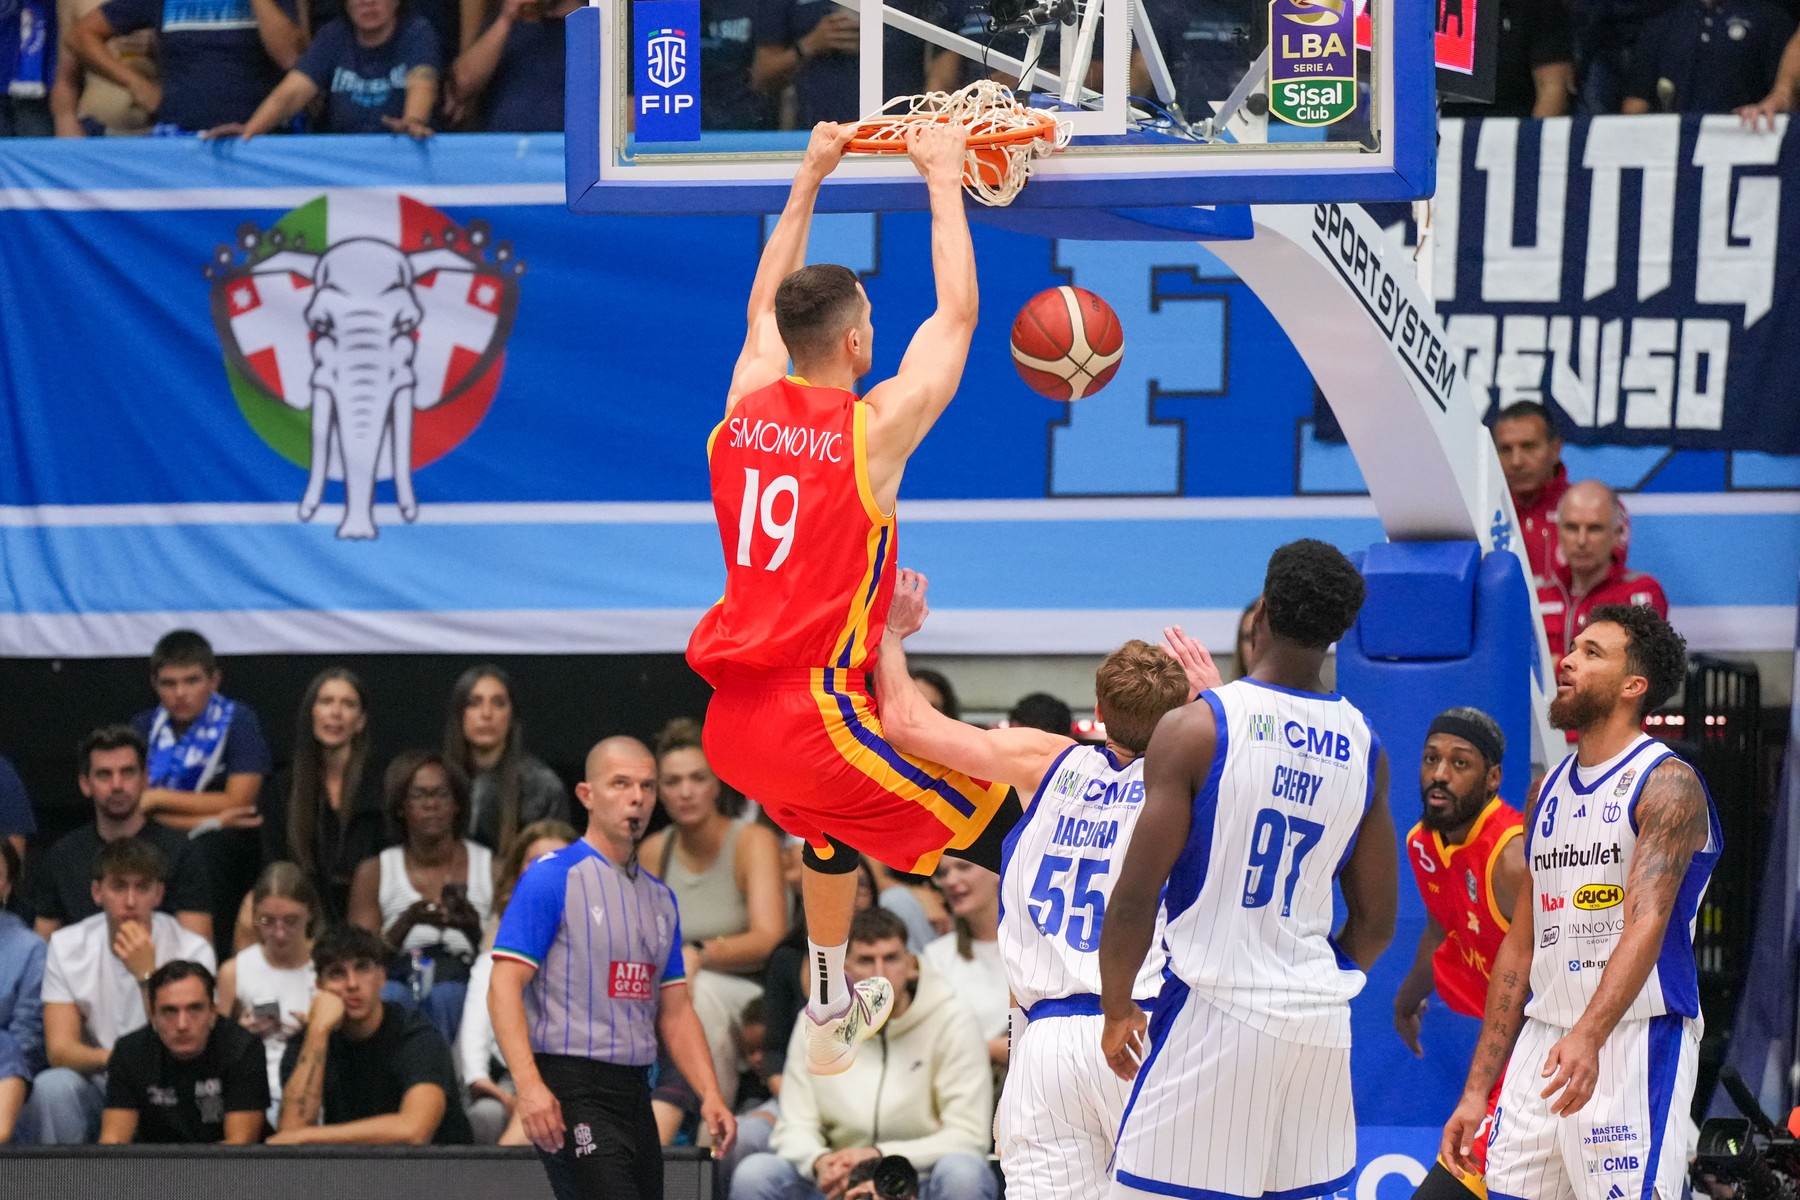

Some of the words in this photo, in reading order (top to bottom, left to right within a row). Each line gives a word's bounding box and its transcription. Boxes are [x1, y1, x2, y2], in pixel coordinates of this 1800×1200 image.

[1282, 33, 1347, 58] LBA
[1293, 63, 1323, 72] SERIE
[1326, 63, 1334, 71] A
[641, 94, 694, 114] FIP
[1283, 82, 1342, 106] Sisal
[1296, 107, 1329, 120] Club
[1437, 314, 1730, 430] REVISO
[736, 467, 799, 572] 19
[1284, 720, 1351, 762] CMB
[1083, 778, 1145, 806] CMB
[1271, 765, 1323, 806] CHERY
[1541, 796, 1559, 838] 3
[1241, 808, 1326, 918] 97
[1027, 853, 1111, 953] 55
[1576, 888, 1619, 904] CRICH
[1568, 920, 1624, 934] INNOVO
[615, 962, 650, 981] ATTA
[1582, 960, 1595, 968] db
[1592, 1125, 1629, 1136] MASTER
[1592, 1133, 1638, 1144] BUILDERS
[575, 1143, 597, 1158] FIP
[1603, 1156, 1639, 1171] CMB
